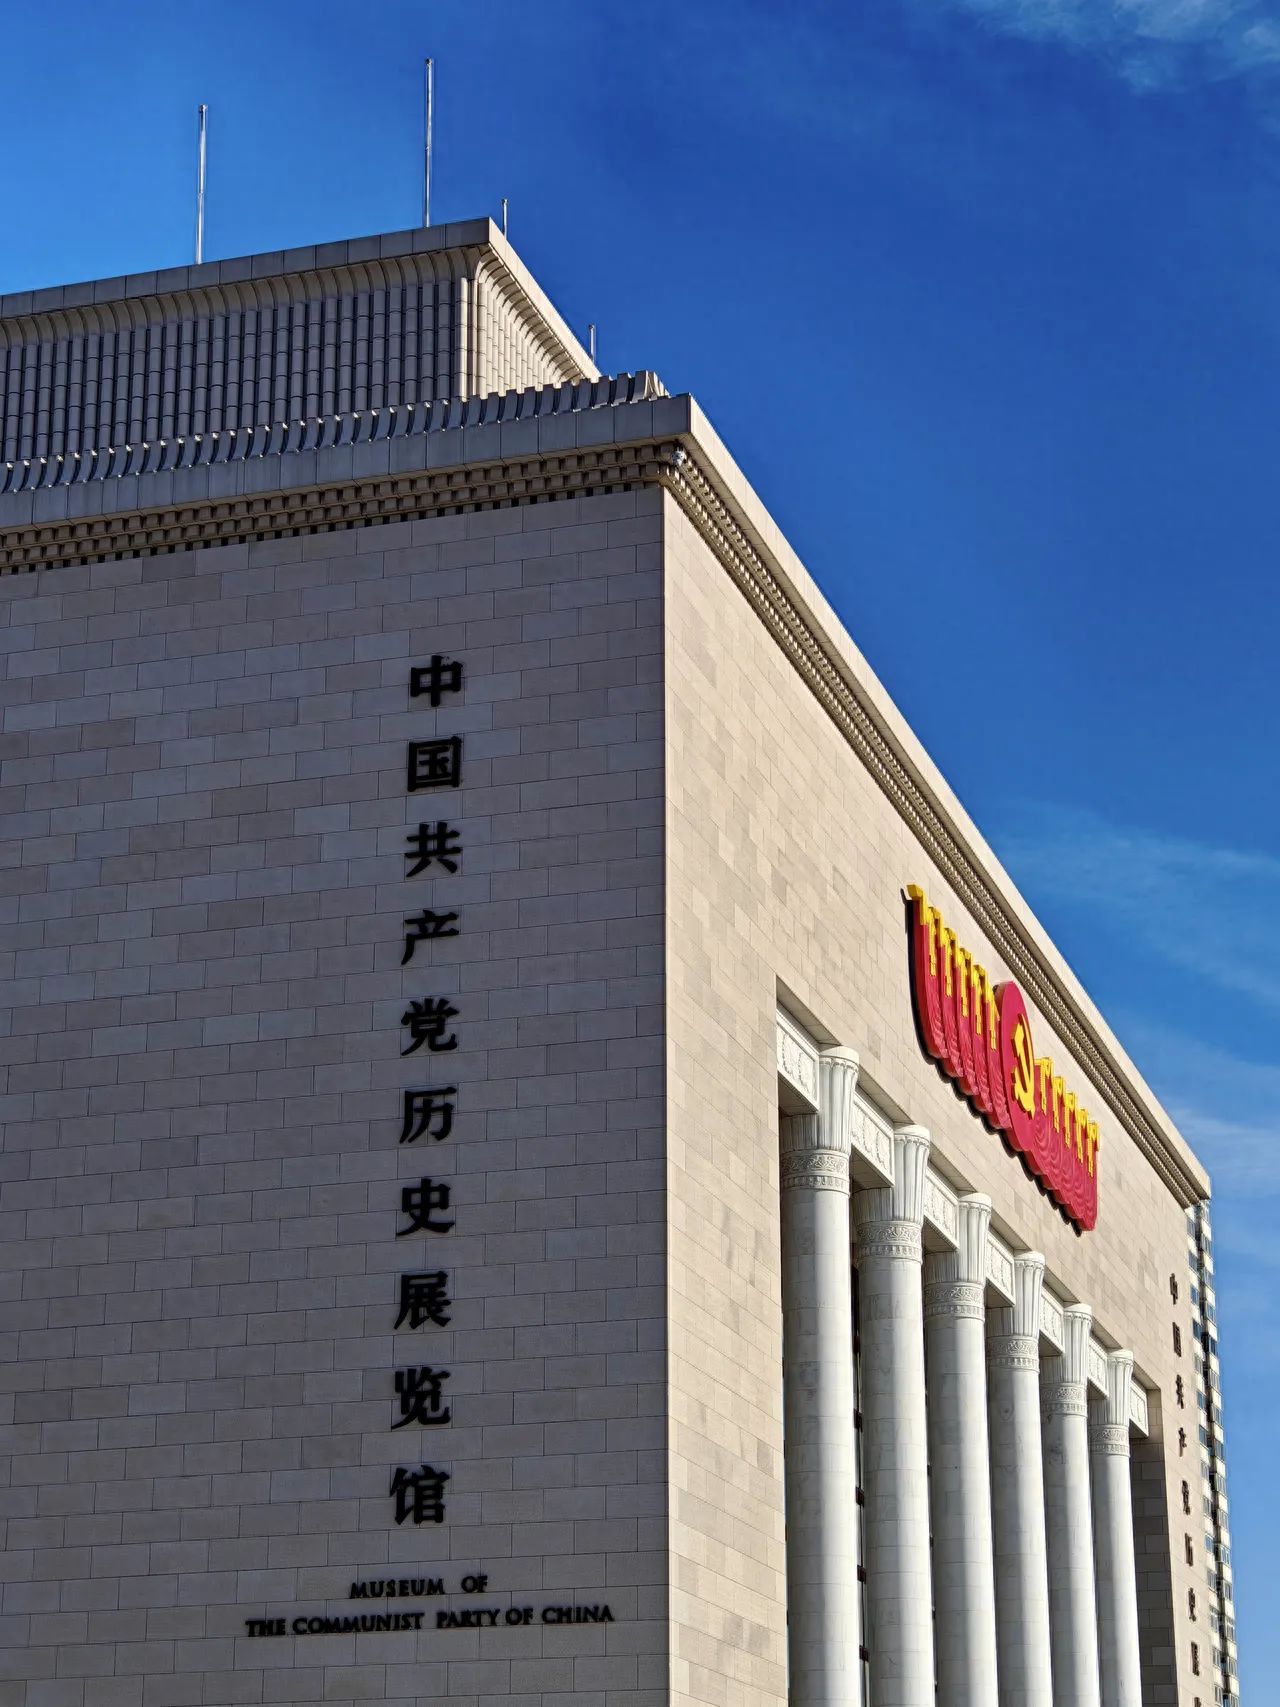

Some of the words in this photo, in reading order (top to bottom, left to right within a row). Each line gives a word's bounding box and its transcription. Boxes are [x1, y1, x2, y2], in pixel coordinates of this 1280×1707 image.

[390, 655, 464, 1526] 中国共产党历史展览馆
[348, 1577, 446, 1600] MUSEUM
[461, 1573, 488, 1594] OF
[245, 1617, 286, 1638] THE
[291, 1612, 425, 1636] COMMUNIST
[436, 1608, 501, 1629] PARTY
[504, 1605, 534, 1626] OF
[540, 1604, 615, 1625] CHINA
